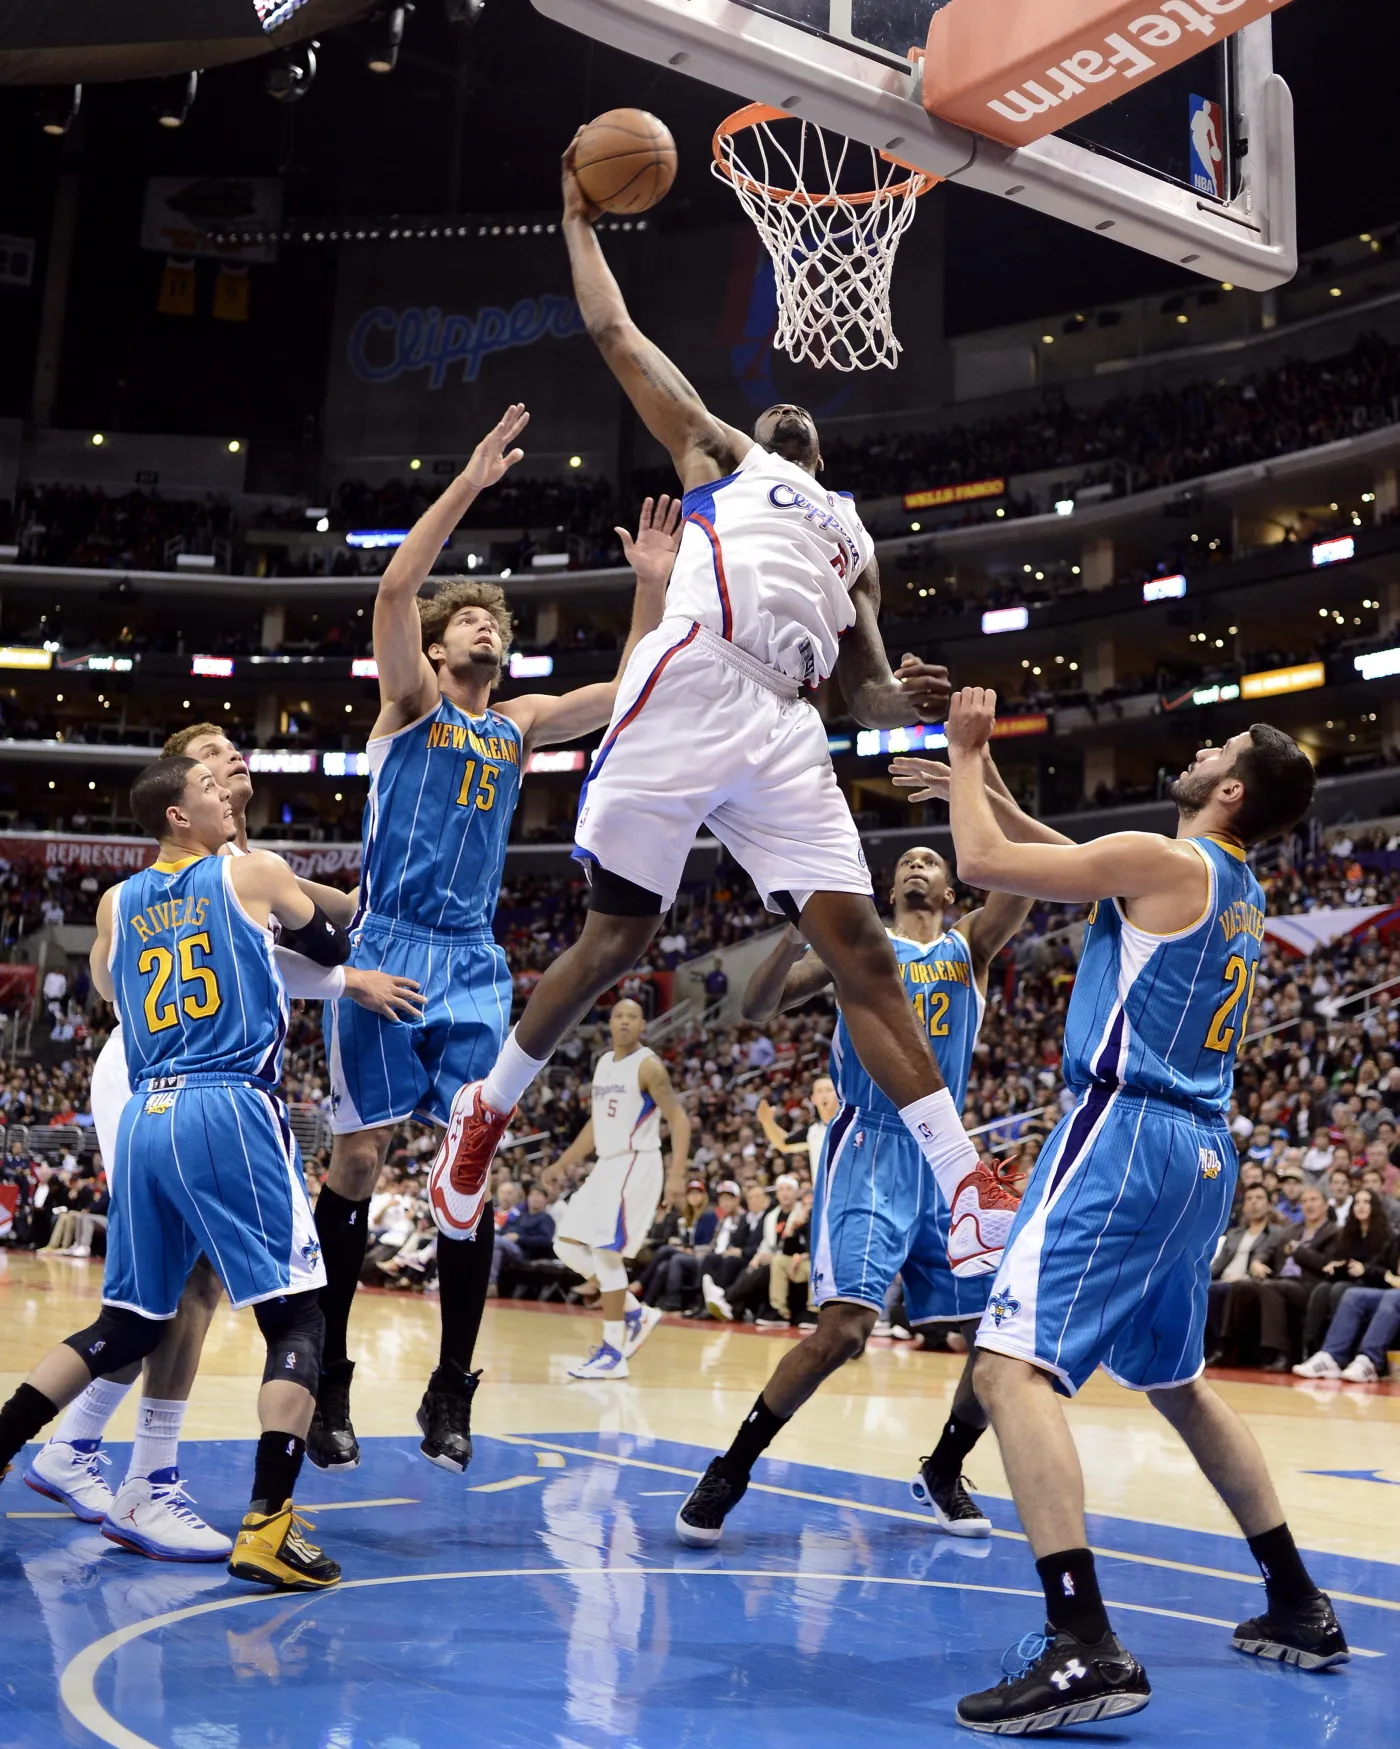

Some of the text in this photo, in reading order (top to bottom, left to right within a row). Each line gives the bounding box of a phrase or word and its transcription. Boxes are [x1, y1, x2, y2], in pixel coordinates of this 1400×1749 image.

[1194, 173, 1213, 194] NBA
[426, 722, 468, 750] NEW
[456, 759, 500, 811] 15
[45, 842, 145, 868] REPRESENT
[130, 897, 210, 943] RIVERS
[137, 931, 222, 1035] 25
[607, 1098, 618, 1118] 5
